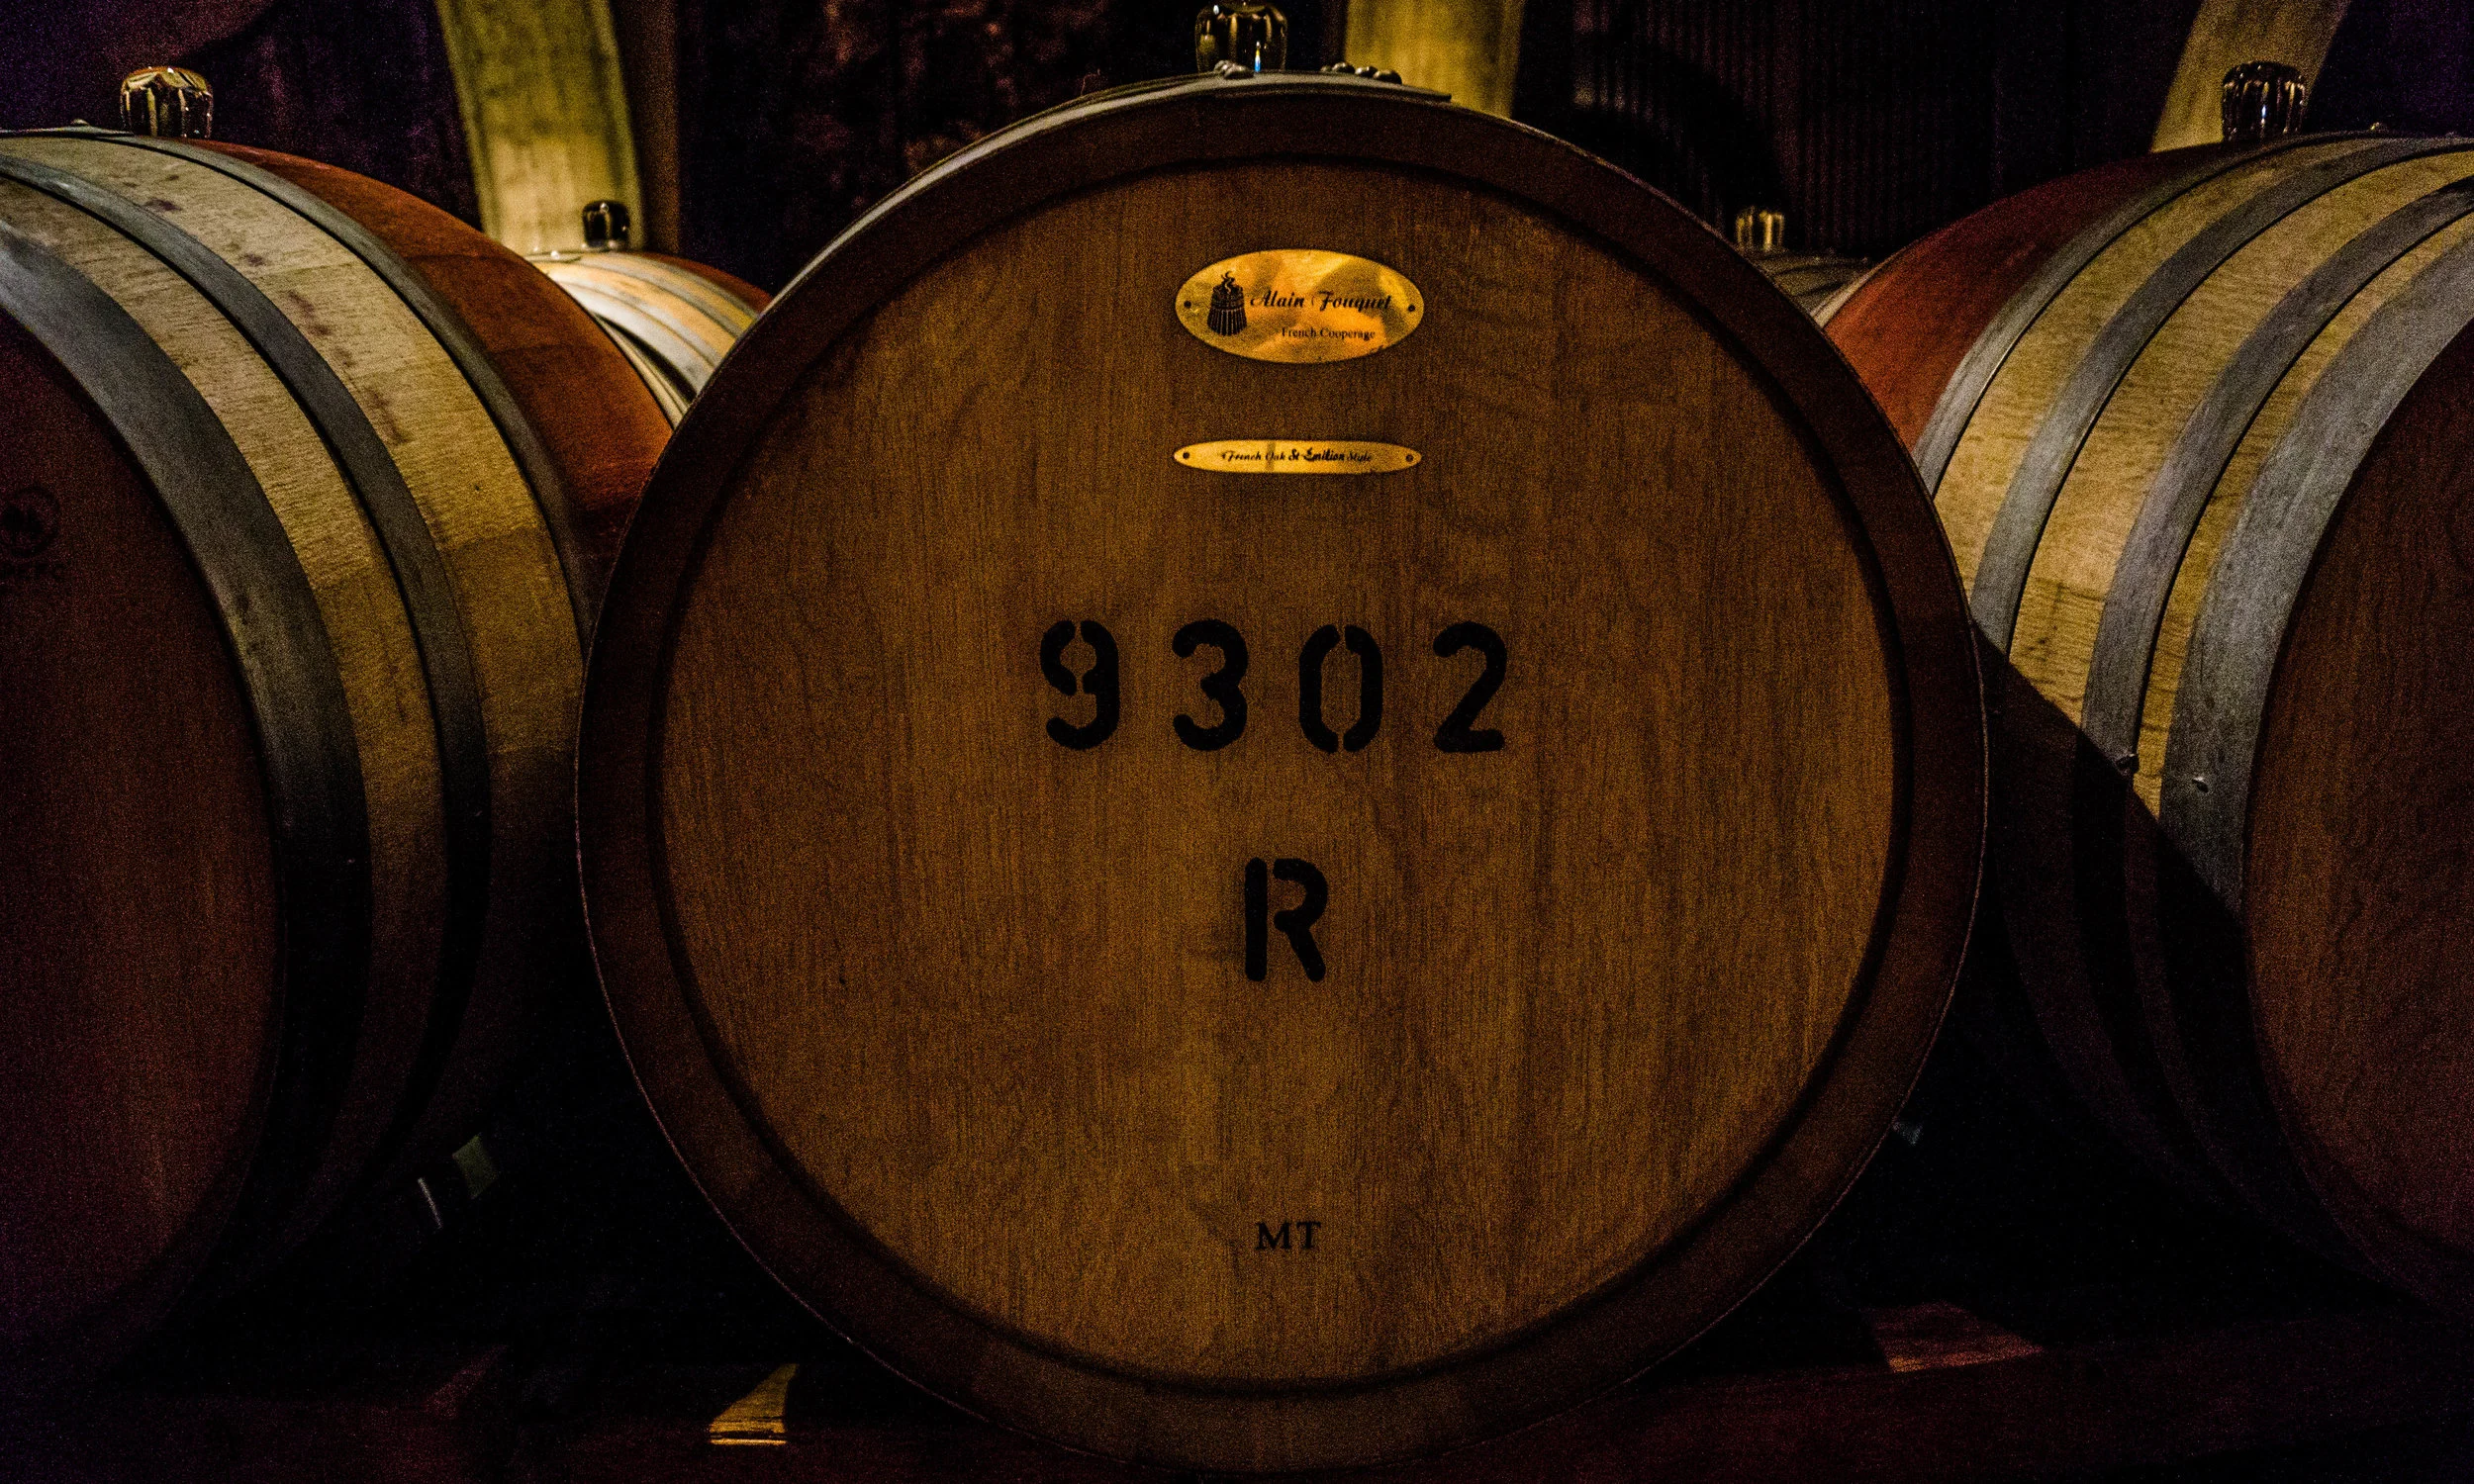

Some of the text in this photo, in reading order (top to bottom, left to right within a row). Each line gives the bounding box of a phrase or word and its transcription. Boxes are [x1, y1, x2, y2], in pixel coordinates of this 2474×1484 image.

[1250, 290, 1391, 312] Alain Fouquet
[1281, 326, 1376, 341] French Cooperage
[1221, 450, 1262, 462] French
[1040, 618, 1507, 753] 9302
[1245, 858, 1328, 981] R
[1255, 1220, 1321, 1251] MT
